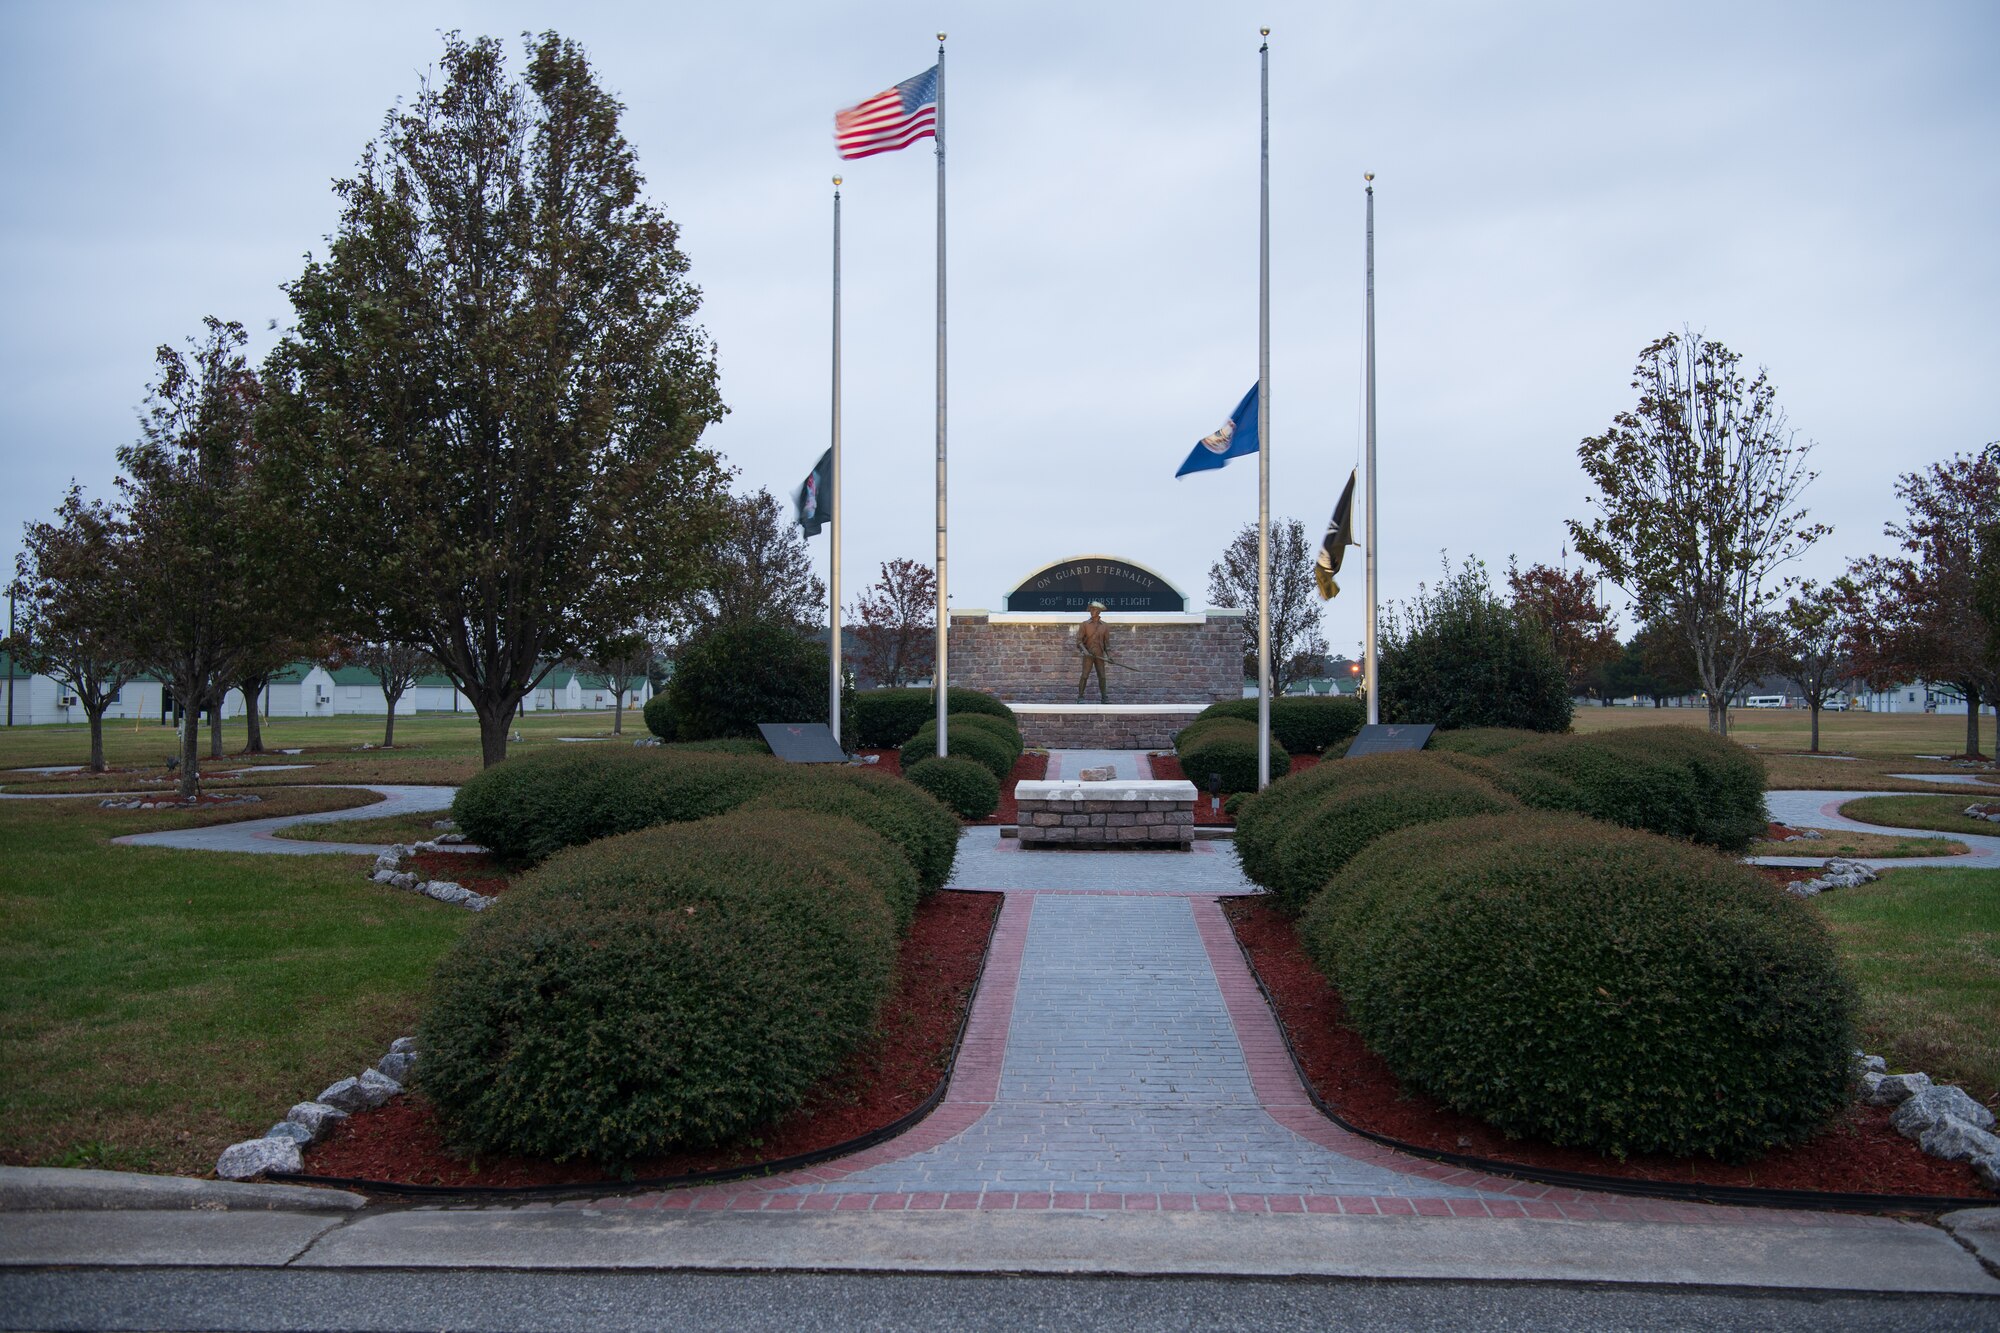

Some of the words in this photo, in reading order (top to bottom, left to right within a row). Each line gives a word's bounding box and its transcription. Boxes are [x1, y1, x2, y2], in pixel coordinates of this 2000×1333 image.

[1038, 577, 1051, 589] ON
[1055, 566, 1091, 581] GUARD
[1096, 566, 1154, 588] ETERNALLY
[1066, 598, 1084, 606] RED
[1120, 598, 1151, 606] FLIGHT
